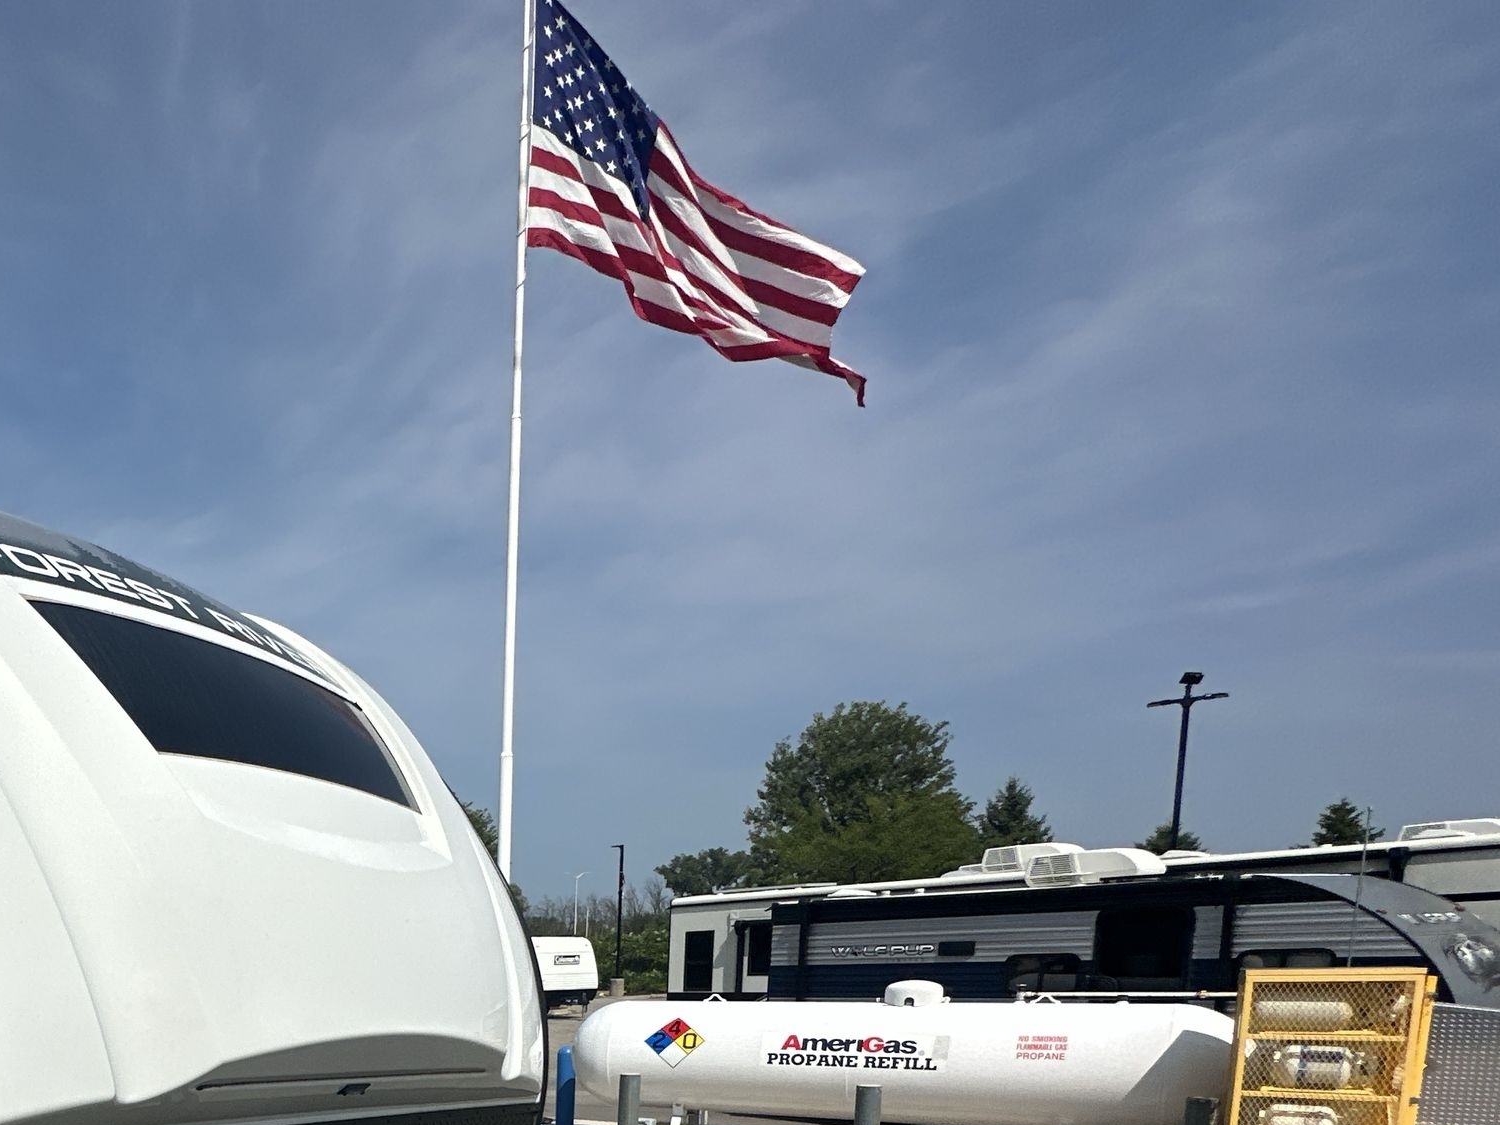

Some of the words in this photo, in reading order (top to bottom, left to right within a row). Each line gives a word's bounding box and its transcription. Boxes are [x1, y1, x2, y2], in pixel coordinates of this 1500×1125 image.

[831, 945, 887, 957] WLF
[890, 944, 935, 956] PUP
[668, 1020, 682, 1035] 4
[652, 1032, 666, 1049] 2
[682, 1032, 697, 1049] 0
[780, 1034, 918, 1054] AmeriGas
[766, 1052, 858, 1068] PROPANE
[863, 1055, 937, 1071] REFILL
[1016, 1052, 1066, 1061] PROPANE
